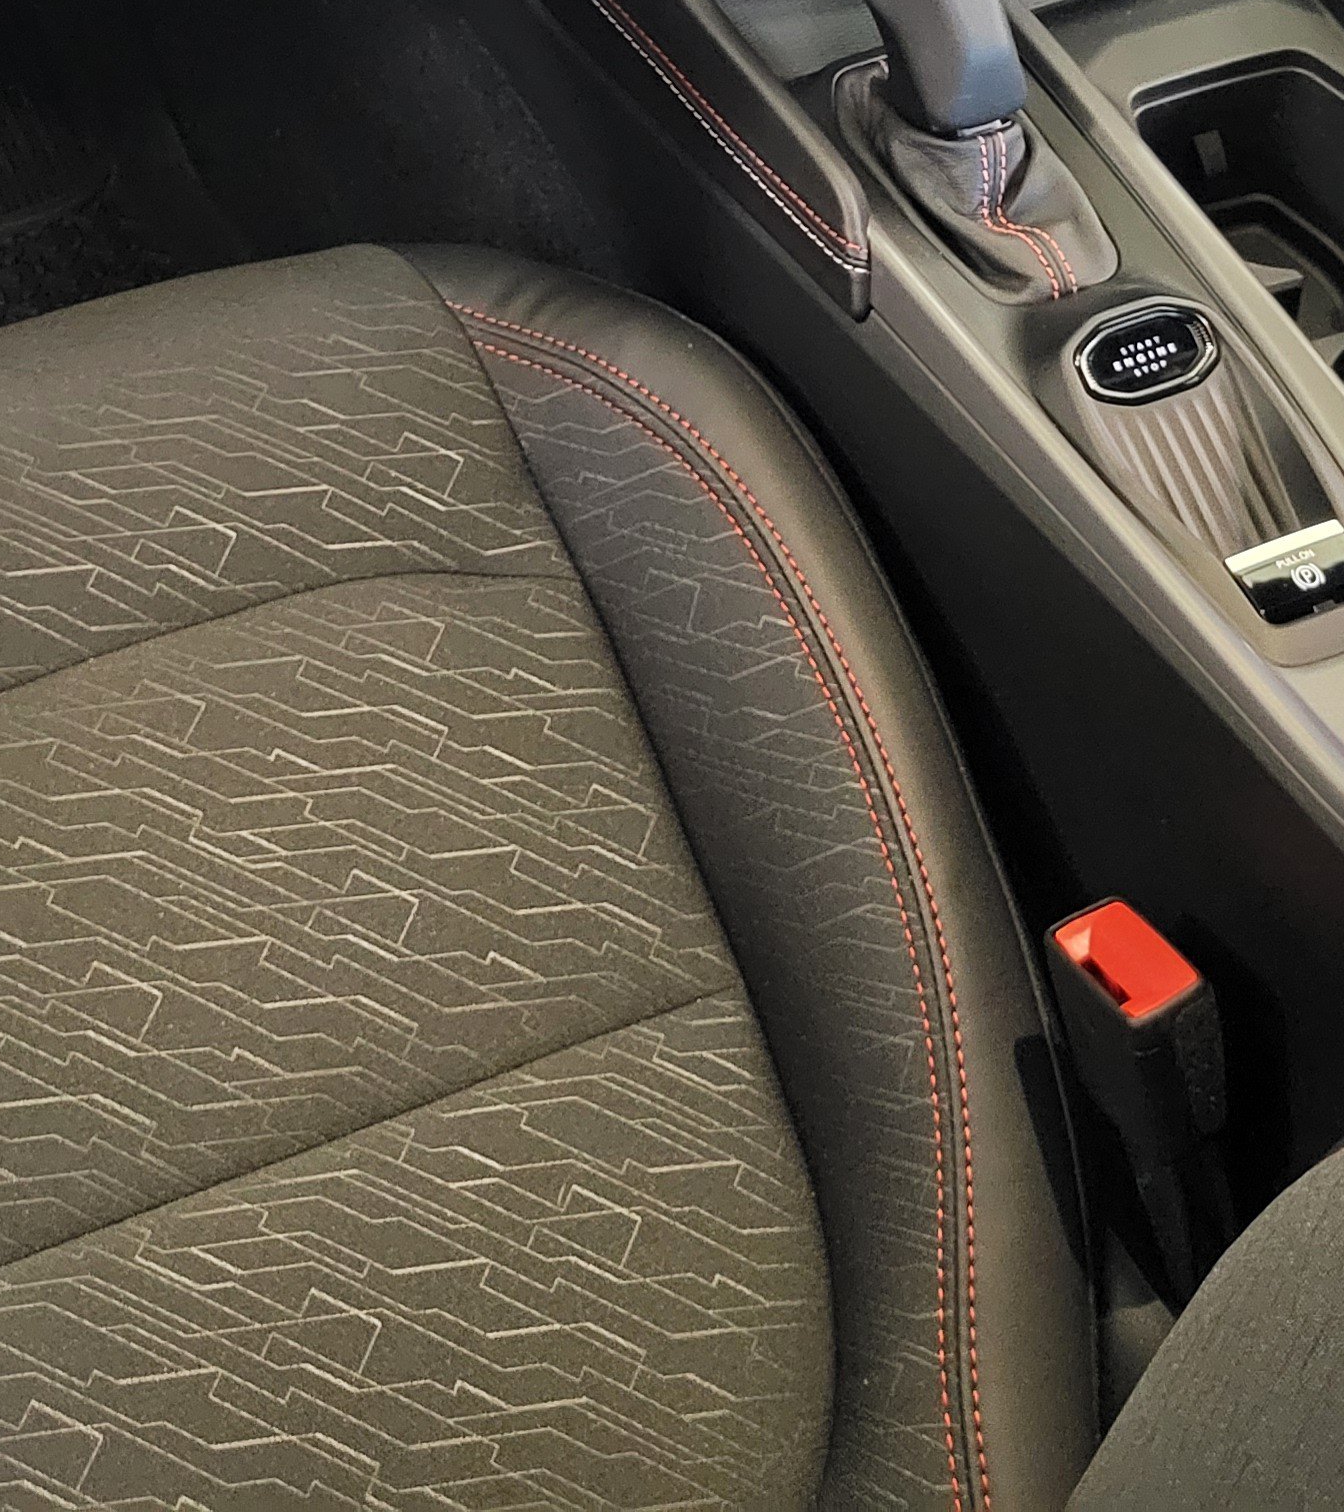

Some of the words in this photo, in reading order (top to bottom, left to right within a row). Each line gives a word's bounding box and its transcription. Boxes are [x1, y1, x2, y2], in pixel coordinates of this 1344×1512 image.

[1120, 335, 1161, 356] START
[1112, 342, 1178, 372] ENGINE
[1133, 359, 1168, 378] STOP
[1275, 554, 1300, 569] PULL
[1299, 549, 1316, 560] ON
